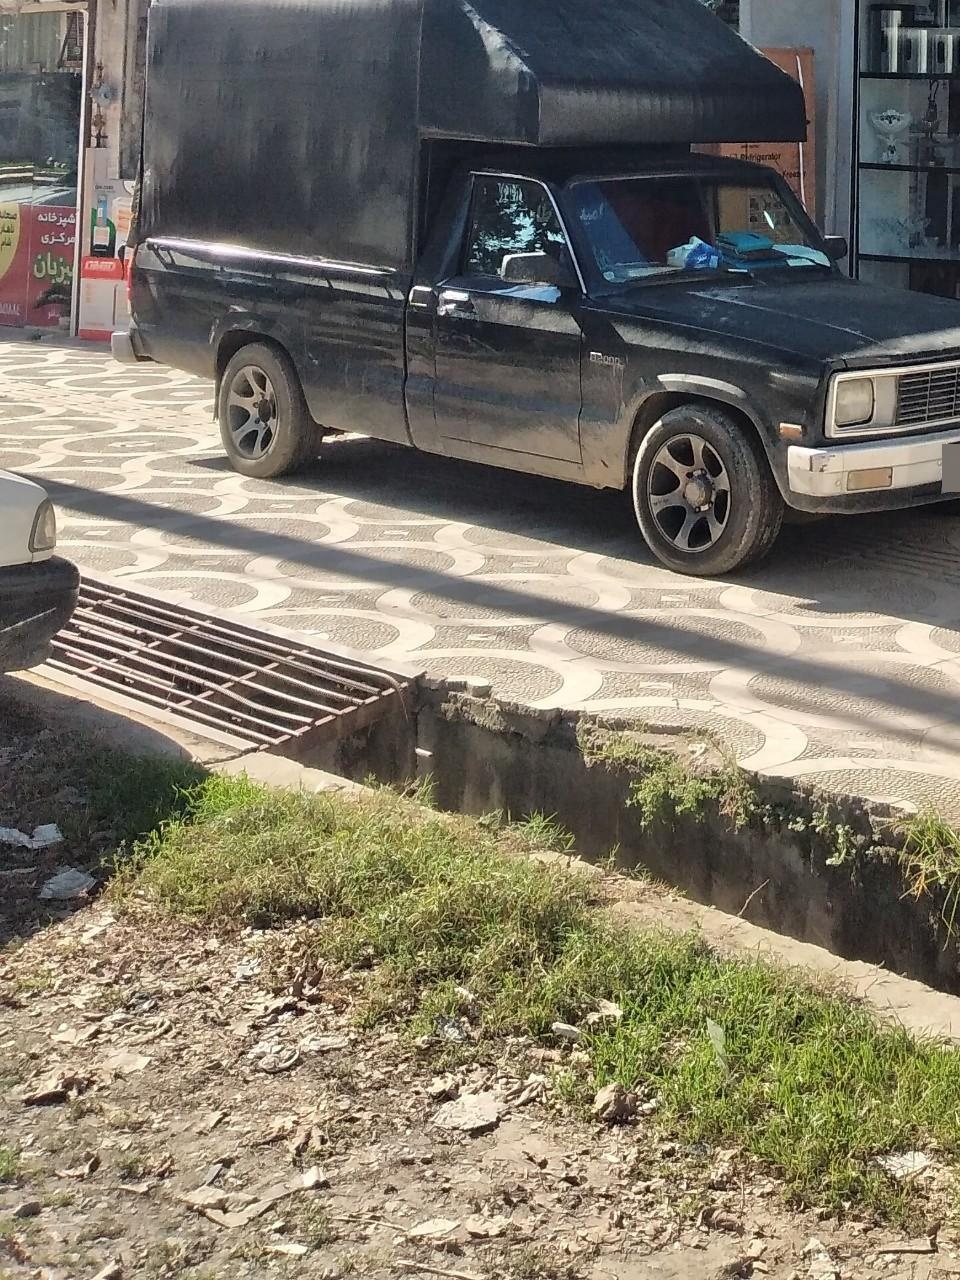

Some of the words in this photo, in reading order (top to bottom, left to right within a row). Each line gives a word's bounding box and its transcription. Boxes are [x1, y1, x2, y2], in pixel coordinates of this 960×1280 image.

[741, 153, 781, 163] Rfrigerator
[37, 211, 77, 228] شپزخانه
[33, 251, 75, 286] یزبان
